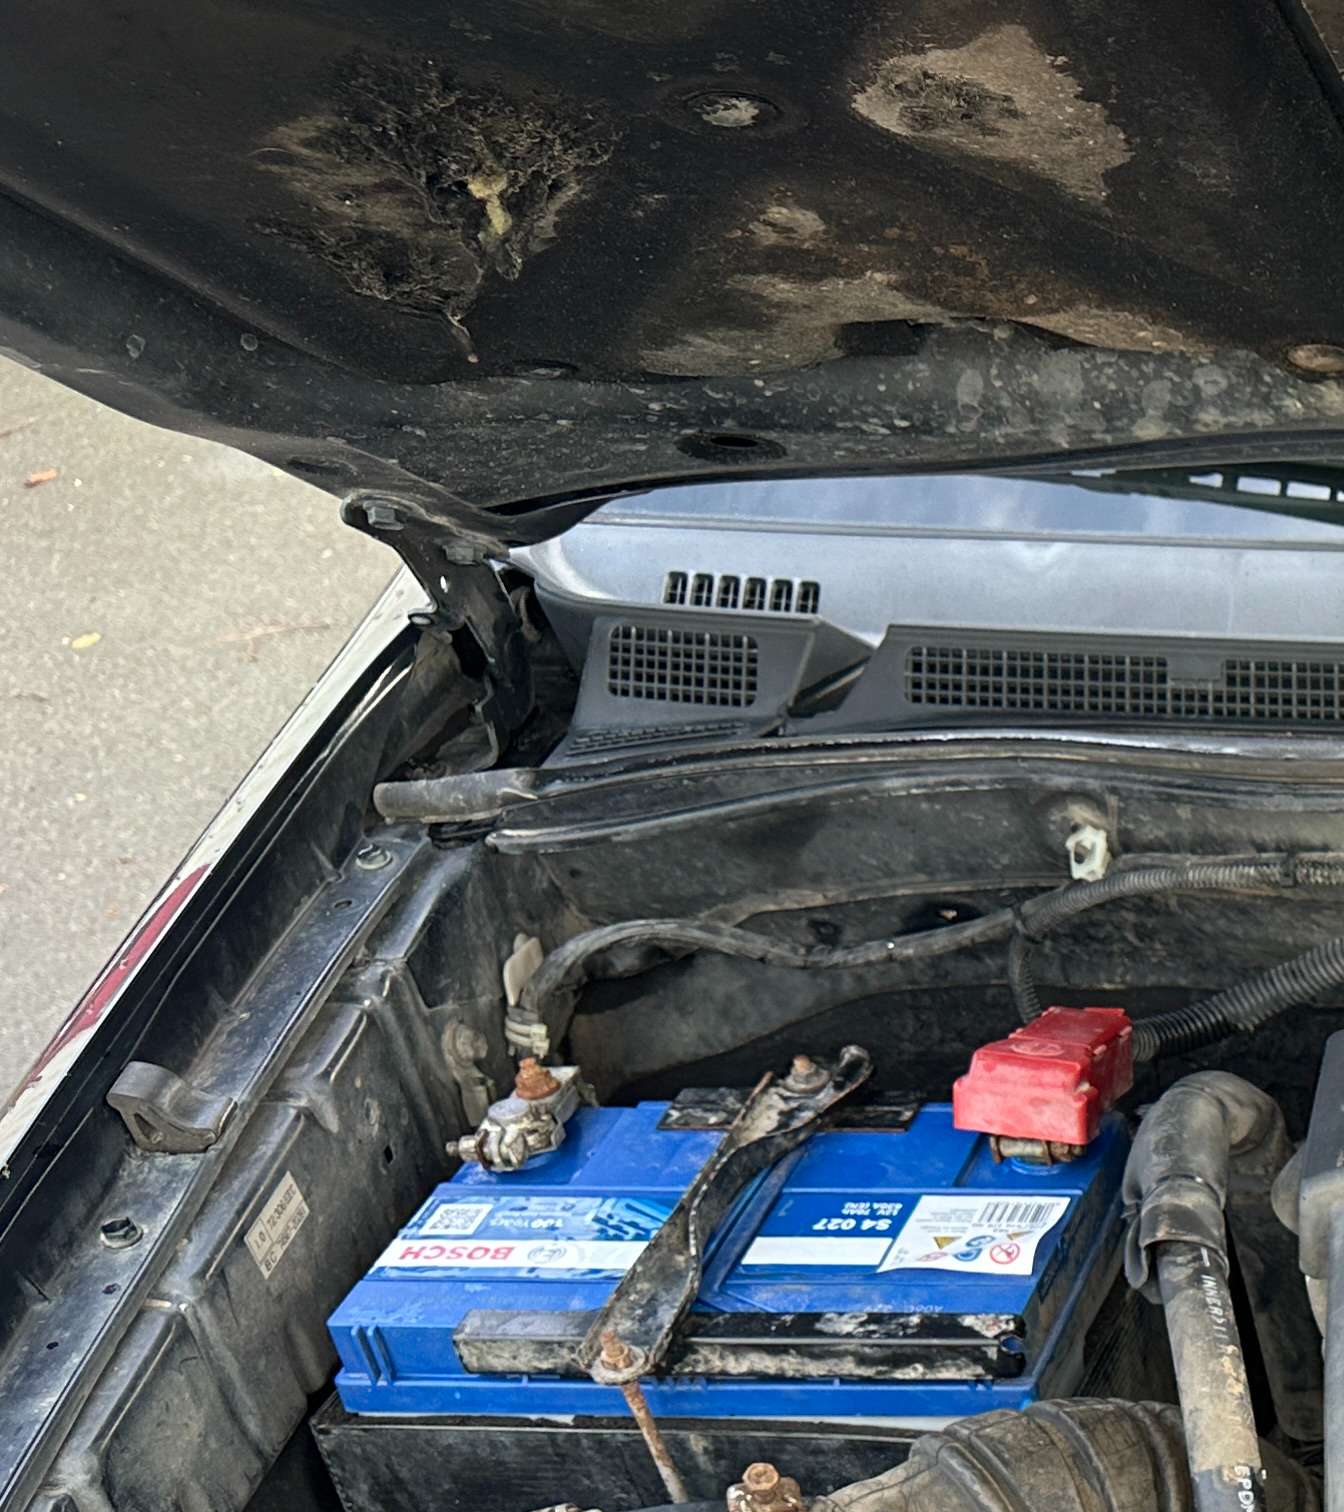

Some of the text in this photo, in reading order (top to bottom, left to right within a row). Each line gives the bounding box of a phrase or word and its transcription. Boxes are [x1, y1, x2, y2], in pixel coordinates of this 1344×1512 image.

[813, 1219, 893, 1230] S4 027
[399, 1246, 515, 1261] BOSCH
